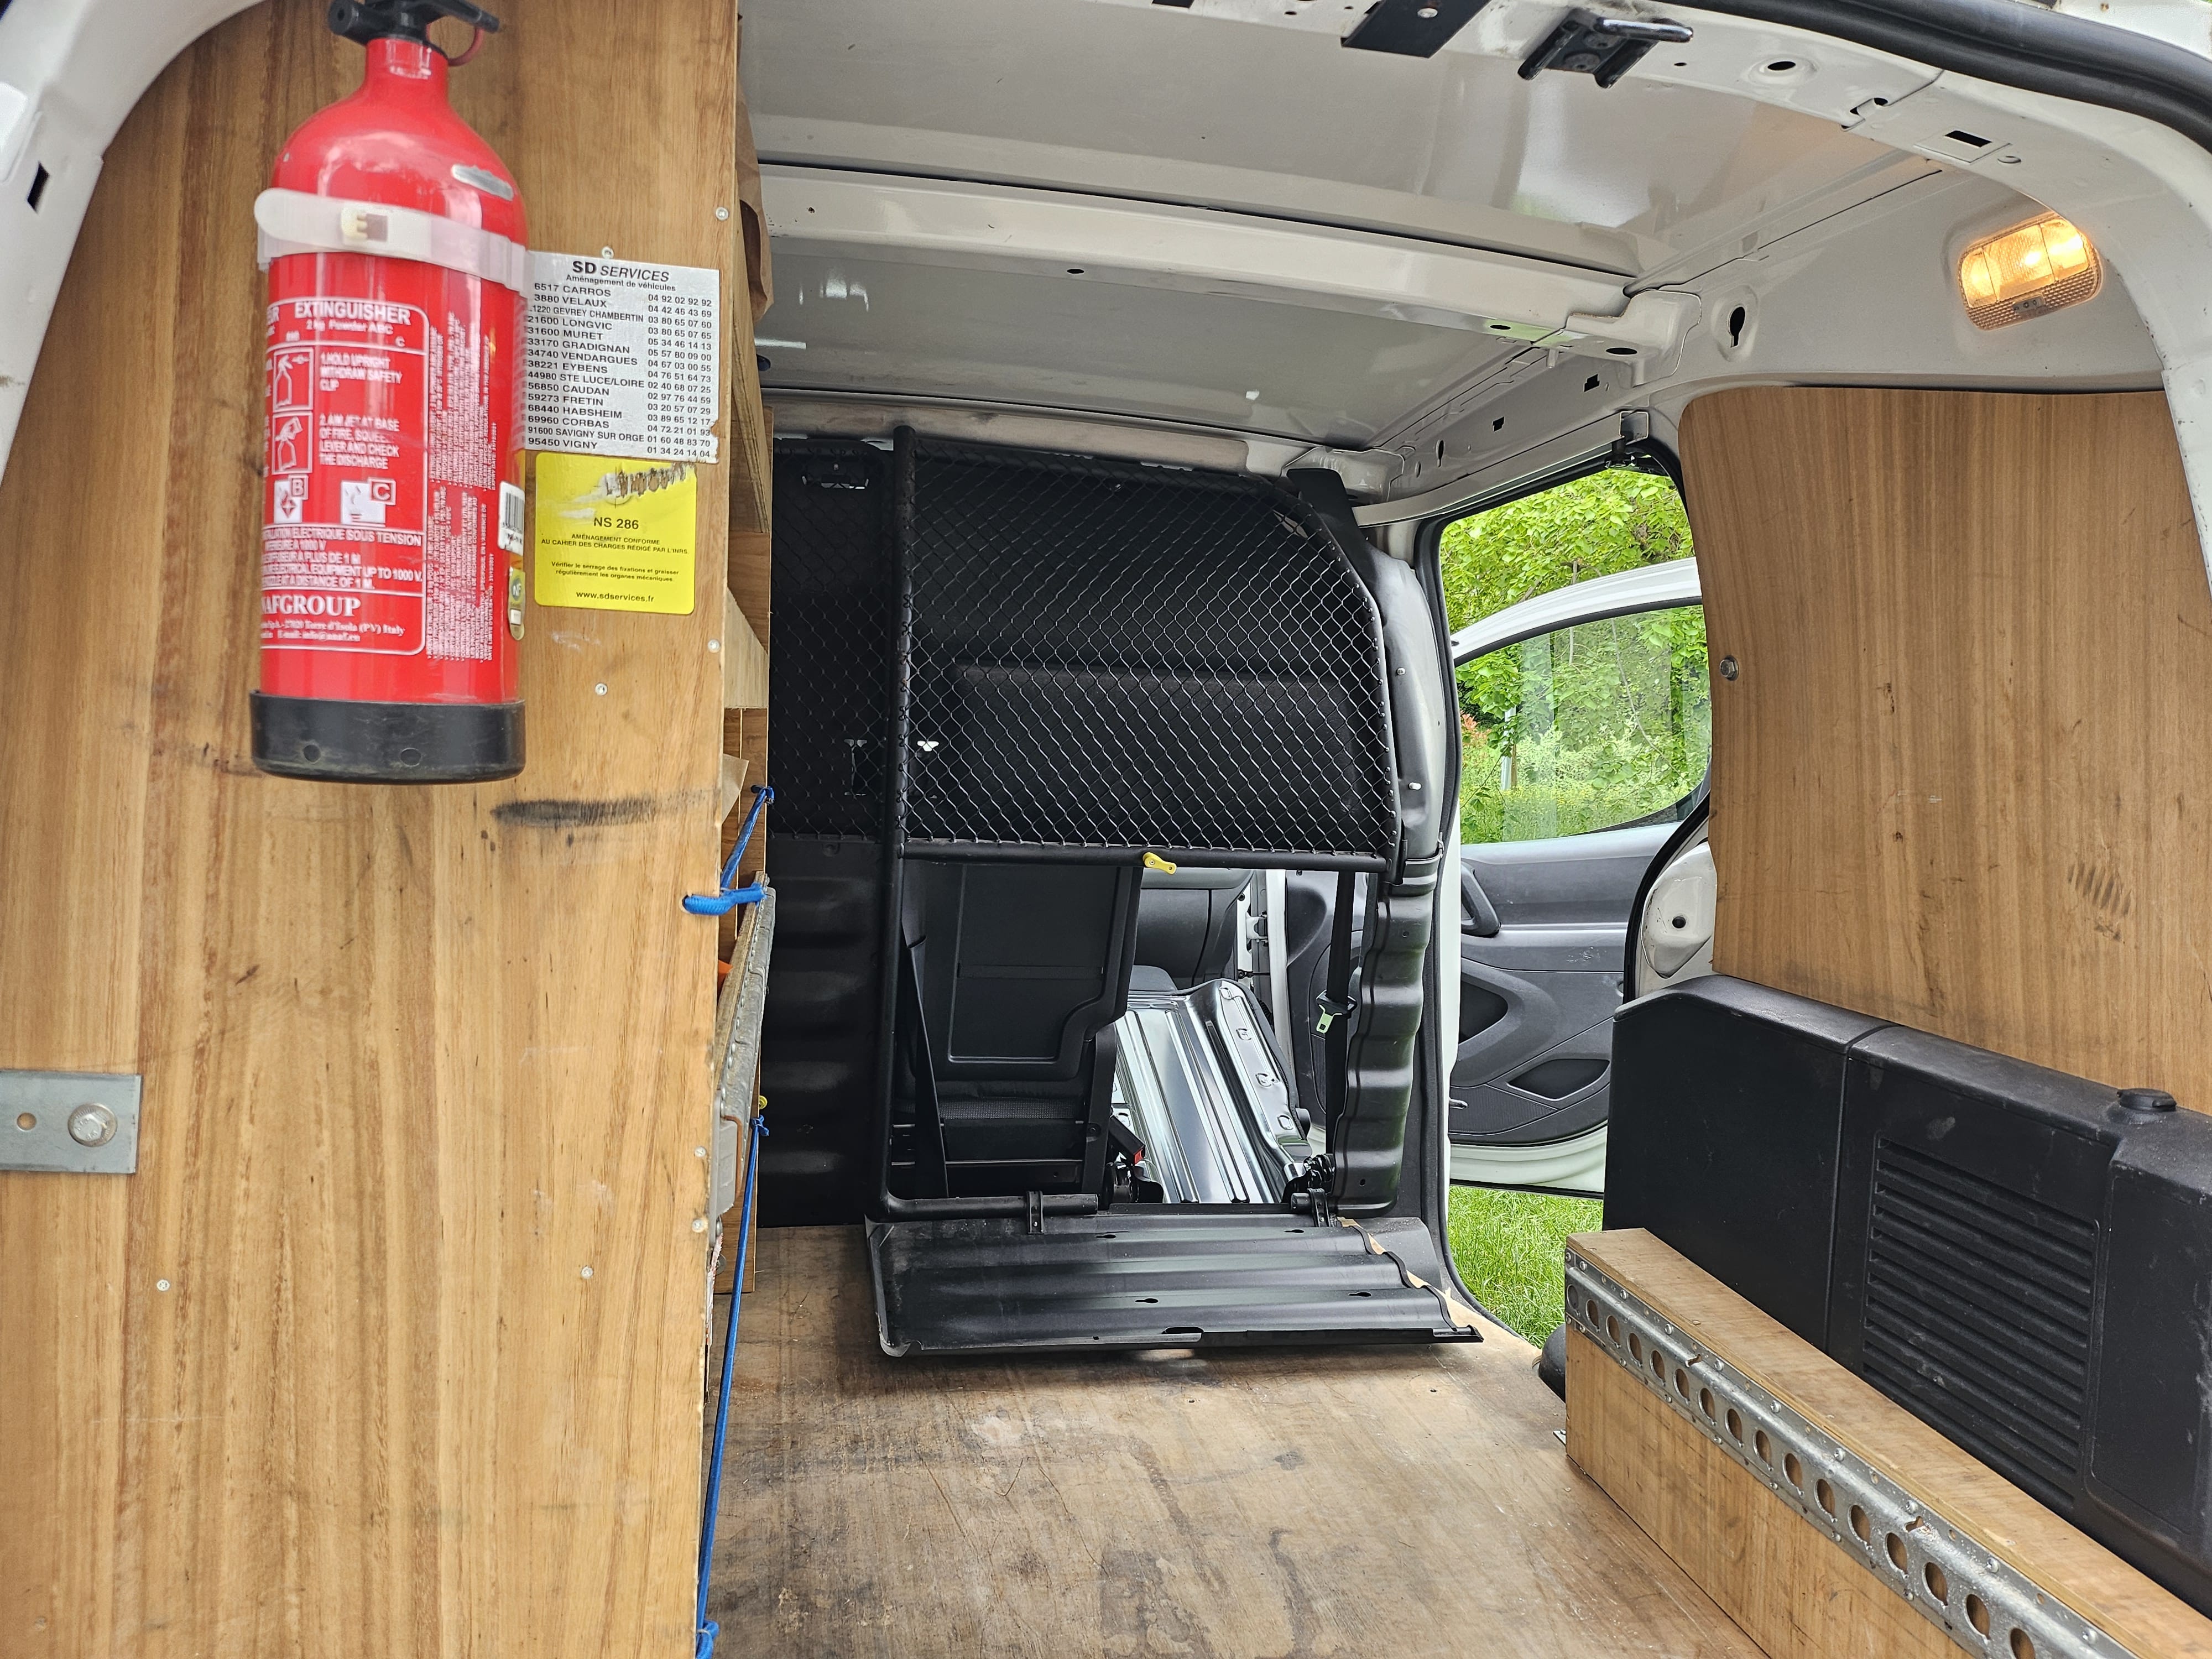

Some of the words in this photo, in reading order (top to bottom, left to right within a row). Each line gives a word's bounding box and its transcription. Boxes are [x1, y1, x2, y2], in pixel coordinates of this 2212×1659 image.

[572, 260, 597, 274] SD
[600, 265, 670, 283] SERVICES
[566, 274, 624, 286] Aménagement
[638, 281, 676, 292] véhicules
[563, 285, 611, 298] CARROS
[688, 298, 699, 306] 92
[295, 301, 411, 326] EXTINGUISHER
[562, 296, 607, 308] VELAUX
[688, 309, 698, 317] 43
[528, 316, 559, 325] 21600
[562, 318, 612, 331] LONGVIC
[553, 307, 587, 317] GEVREY
[589, 310, 644, 322] CHAMBERTIN
[688, 320, 698, 328] 07
[528, 327, 560, 336] 31600
[564, 330, 603, 341] MURET
[528, 338, 559, 347] 33170
[562, 341, 630, 354] GRADIGNAN
[528, 349, 559, 358] 34740
[561, 352, 638, 365] VENDARGUES
[367, 368, 403, 384] SAFETY
[528, 360, 558, 369] 38221
[562, 363, 608, 374] EYBENS
[648, 371, 658, 379] 04
[528, 371, 557, 380] 44980
[560, 373, 580, 382] STE
[583, 375, 644, 388] LUCE/LOIRE
[648, 381, 659, 389] 02
[528, 382, 559, 392] 56850
[562, 385, 609, 395] CAUDAN
[528, 393, 559, 403] 59273
[563, 396, 603, 406] FRETIN
[528, 404, 559, 414] 68440
[563, 406, 623, 419] HABSHEIM
[374, 416, 400, 432] BASE
[528, 415, 559, 425] 69960
[562, 418, 609, 429] CORBAS
[528, 426, 553, 435] 91600
[555, 428, 594, 439] SAVIGNY
[598, 432, 616, 440] SUR
[618, 433, 644, 442] ORGE
[367, 442, 400, 457] CHECK
[528, 437, 560, 446] 95450
[562, 440, 598, 449] VIGNY
[336, 452, 389, 469] DISCHARGE
[292, 478, 304, 495] B
[373, 483, 390, 500] C
[593, 517, 612, 528] NS
[616, 519, 639, 530] 286
[346, 529, 375, 542] SOUS
[376, 531, 421, 547] TENSION
[571, 533, 622, 542] AMÉNAGEMENT
[377, 566, 392, 580] TO
[393, 567, 414, 581] 1000
[576, 591, 654, 602] www.sdservices.fr
